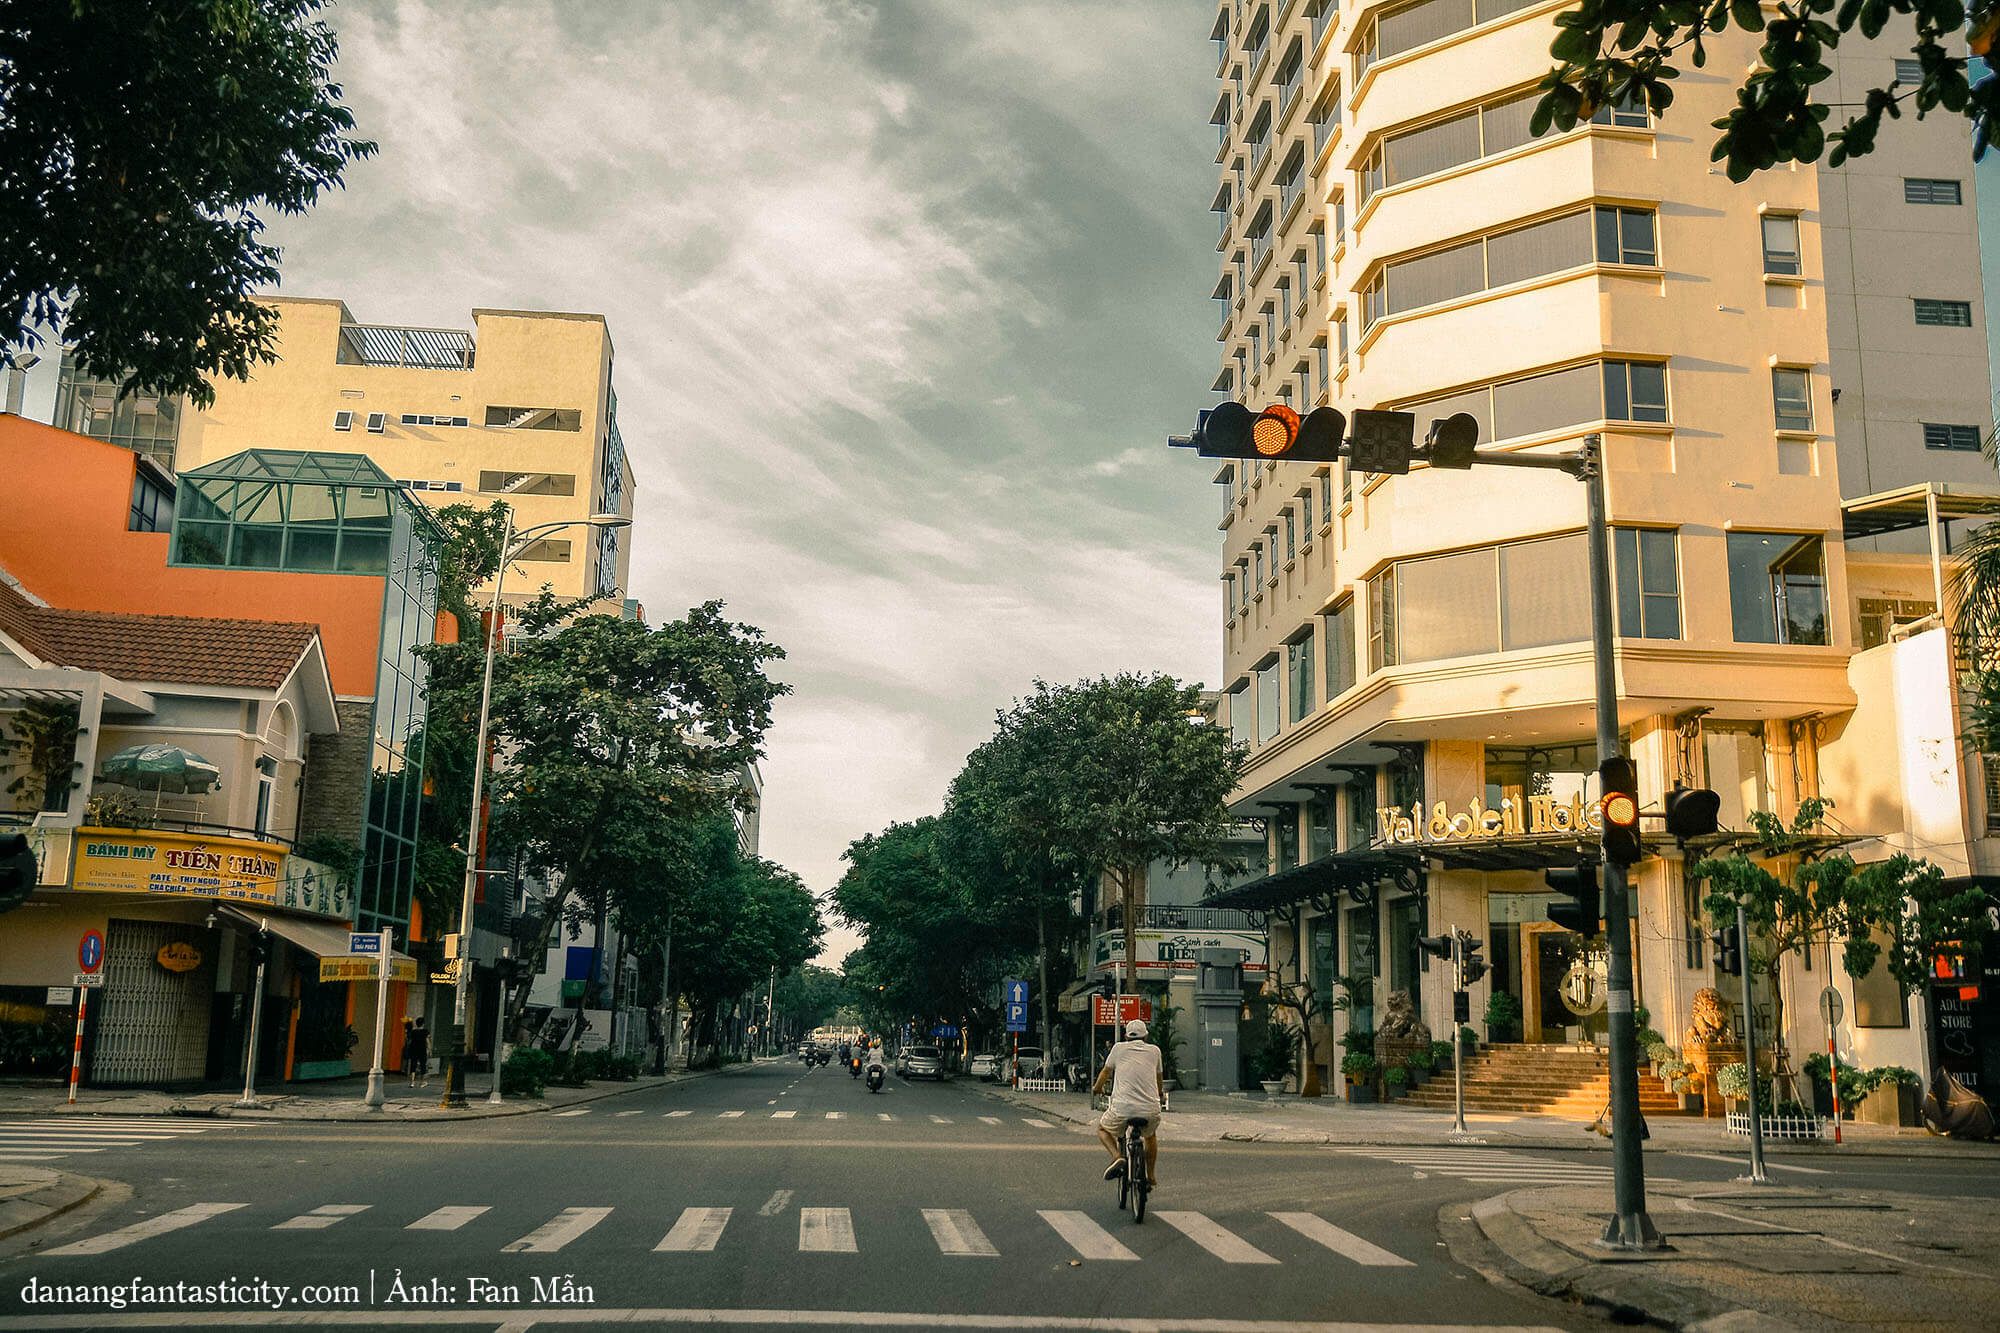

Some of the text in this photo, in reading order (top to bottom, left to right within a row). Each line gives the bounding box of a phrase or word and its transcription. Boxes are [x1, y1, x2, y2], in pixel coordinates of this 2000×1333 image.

[1376, 790, 1602, 844] Val Soleil Hote
[86, 841, 130, 859] BÁNH
[166, 844, 278, 878] TIẾN THÀNH
[1011, 1005, 1023, 1020] P
[1940, 1015, 1972, 1029] STORE
[1953, 1072, 1978, 1085] DULT
